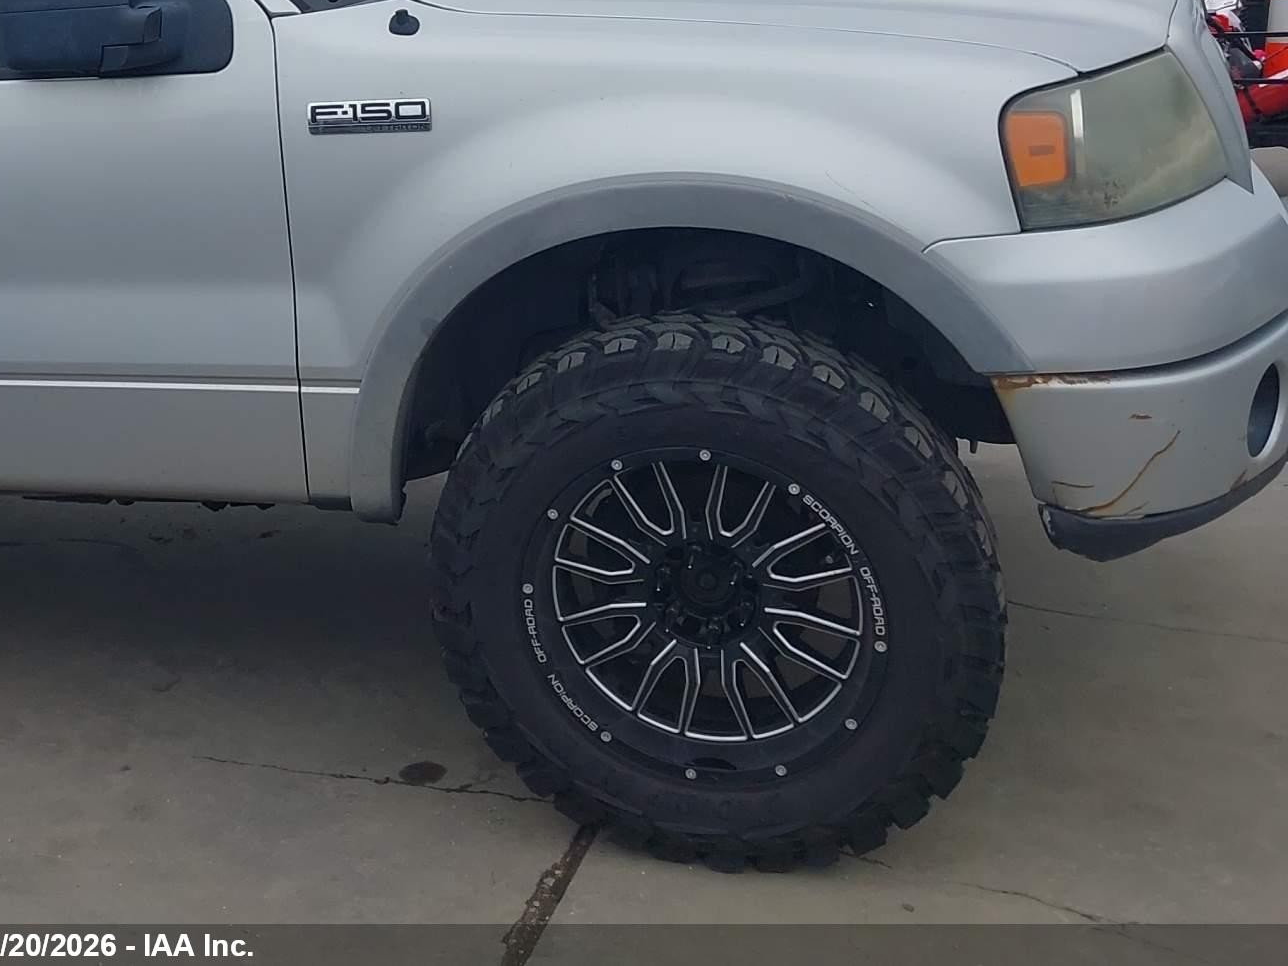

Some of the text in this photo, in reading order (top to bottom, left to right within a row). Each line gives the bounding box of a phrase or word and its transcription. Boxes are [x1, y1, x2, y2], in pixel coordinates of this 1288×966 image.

[310, 100, 427, 123] F-150
[802, 494, 886, 636] SCORPION OFF-ROAD
[523, 598, 599, 732] SCORPION OFF-ROAD
